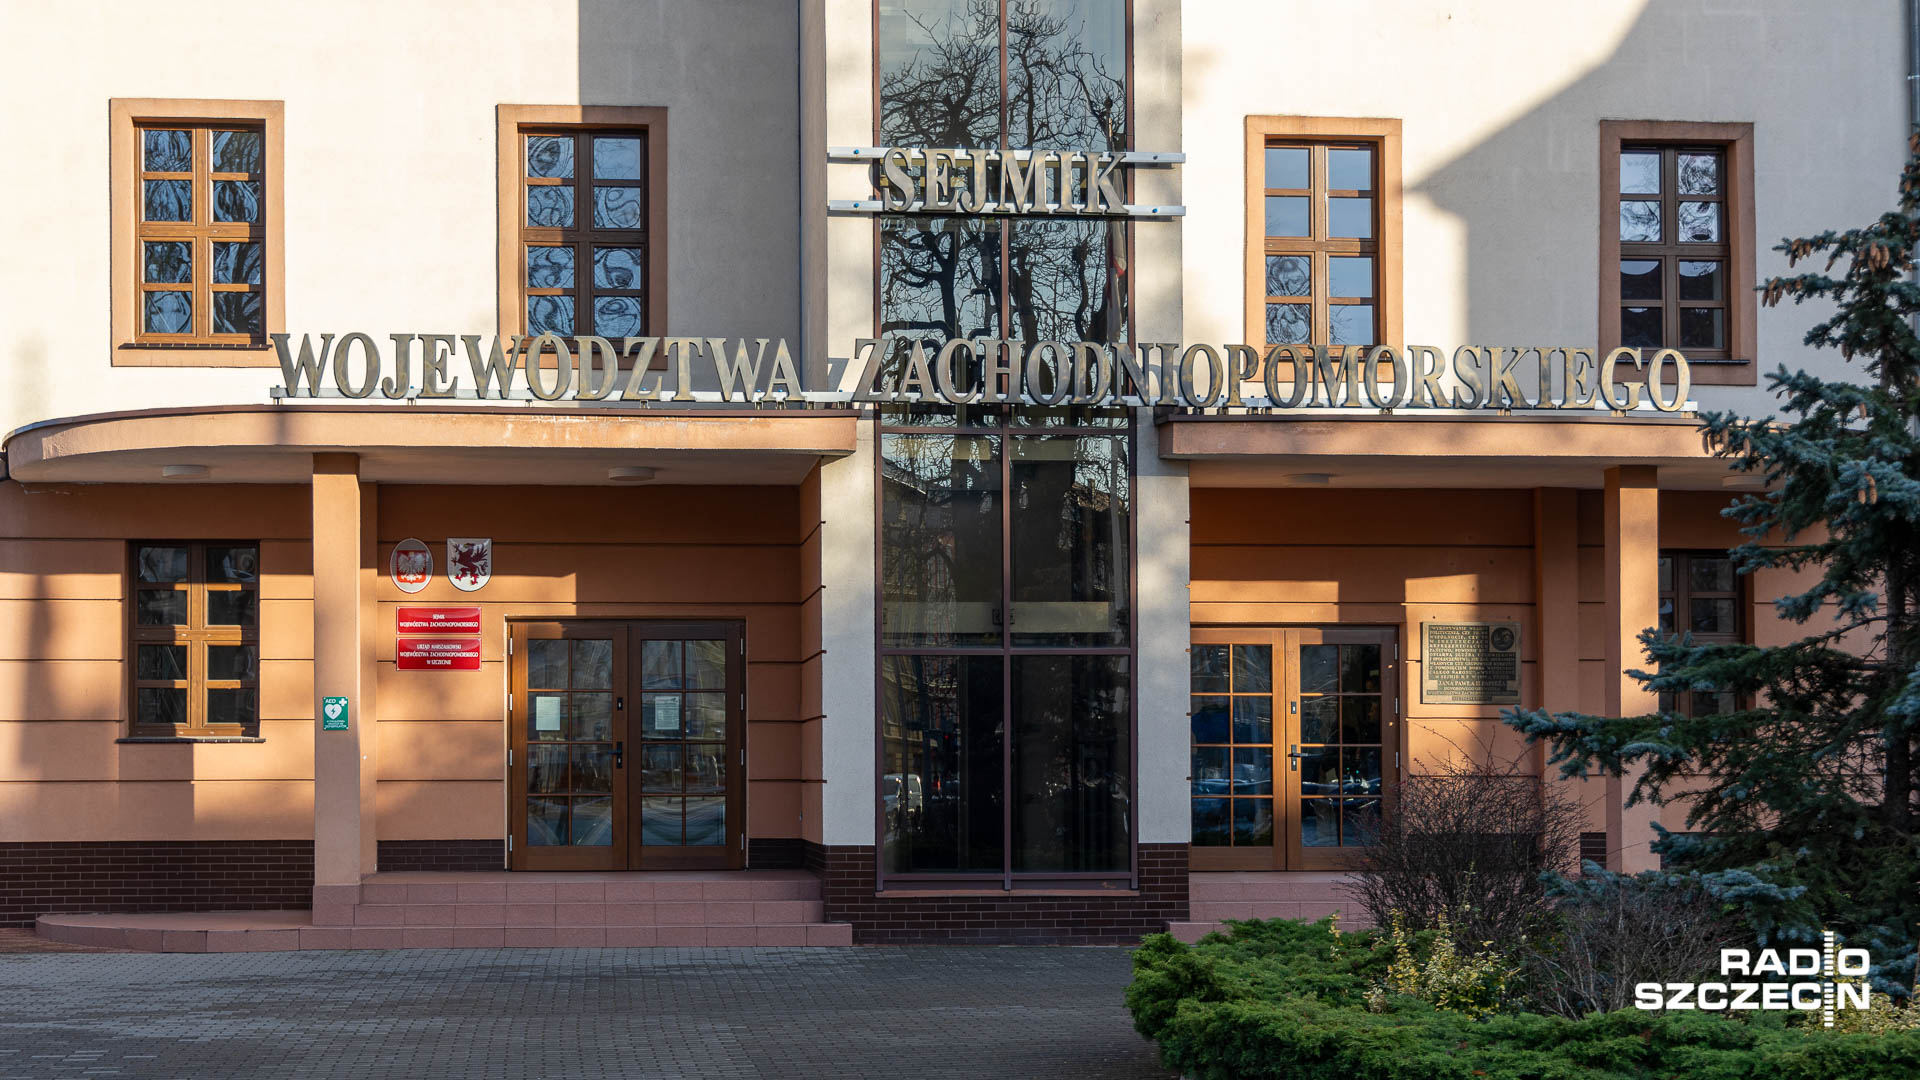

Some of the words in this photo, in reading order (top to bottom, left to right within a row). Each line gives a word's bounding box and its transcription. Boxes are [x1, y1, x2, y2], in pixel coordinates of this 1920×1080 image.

[884, 147, 1129, 215] SEJMIK
[270, 330, 807, 402] WOJEWÓDZTWA
[853, 337, 1692, 412] ZACHODNIOPOMORSKIEGO
